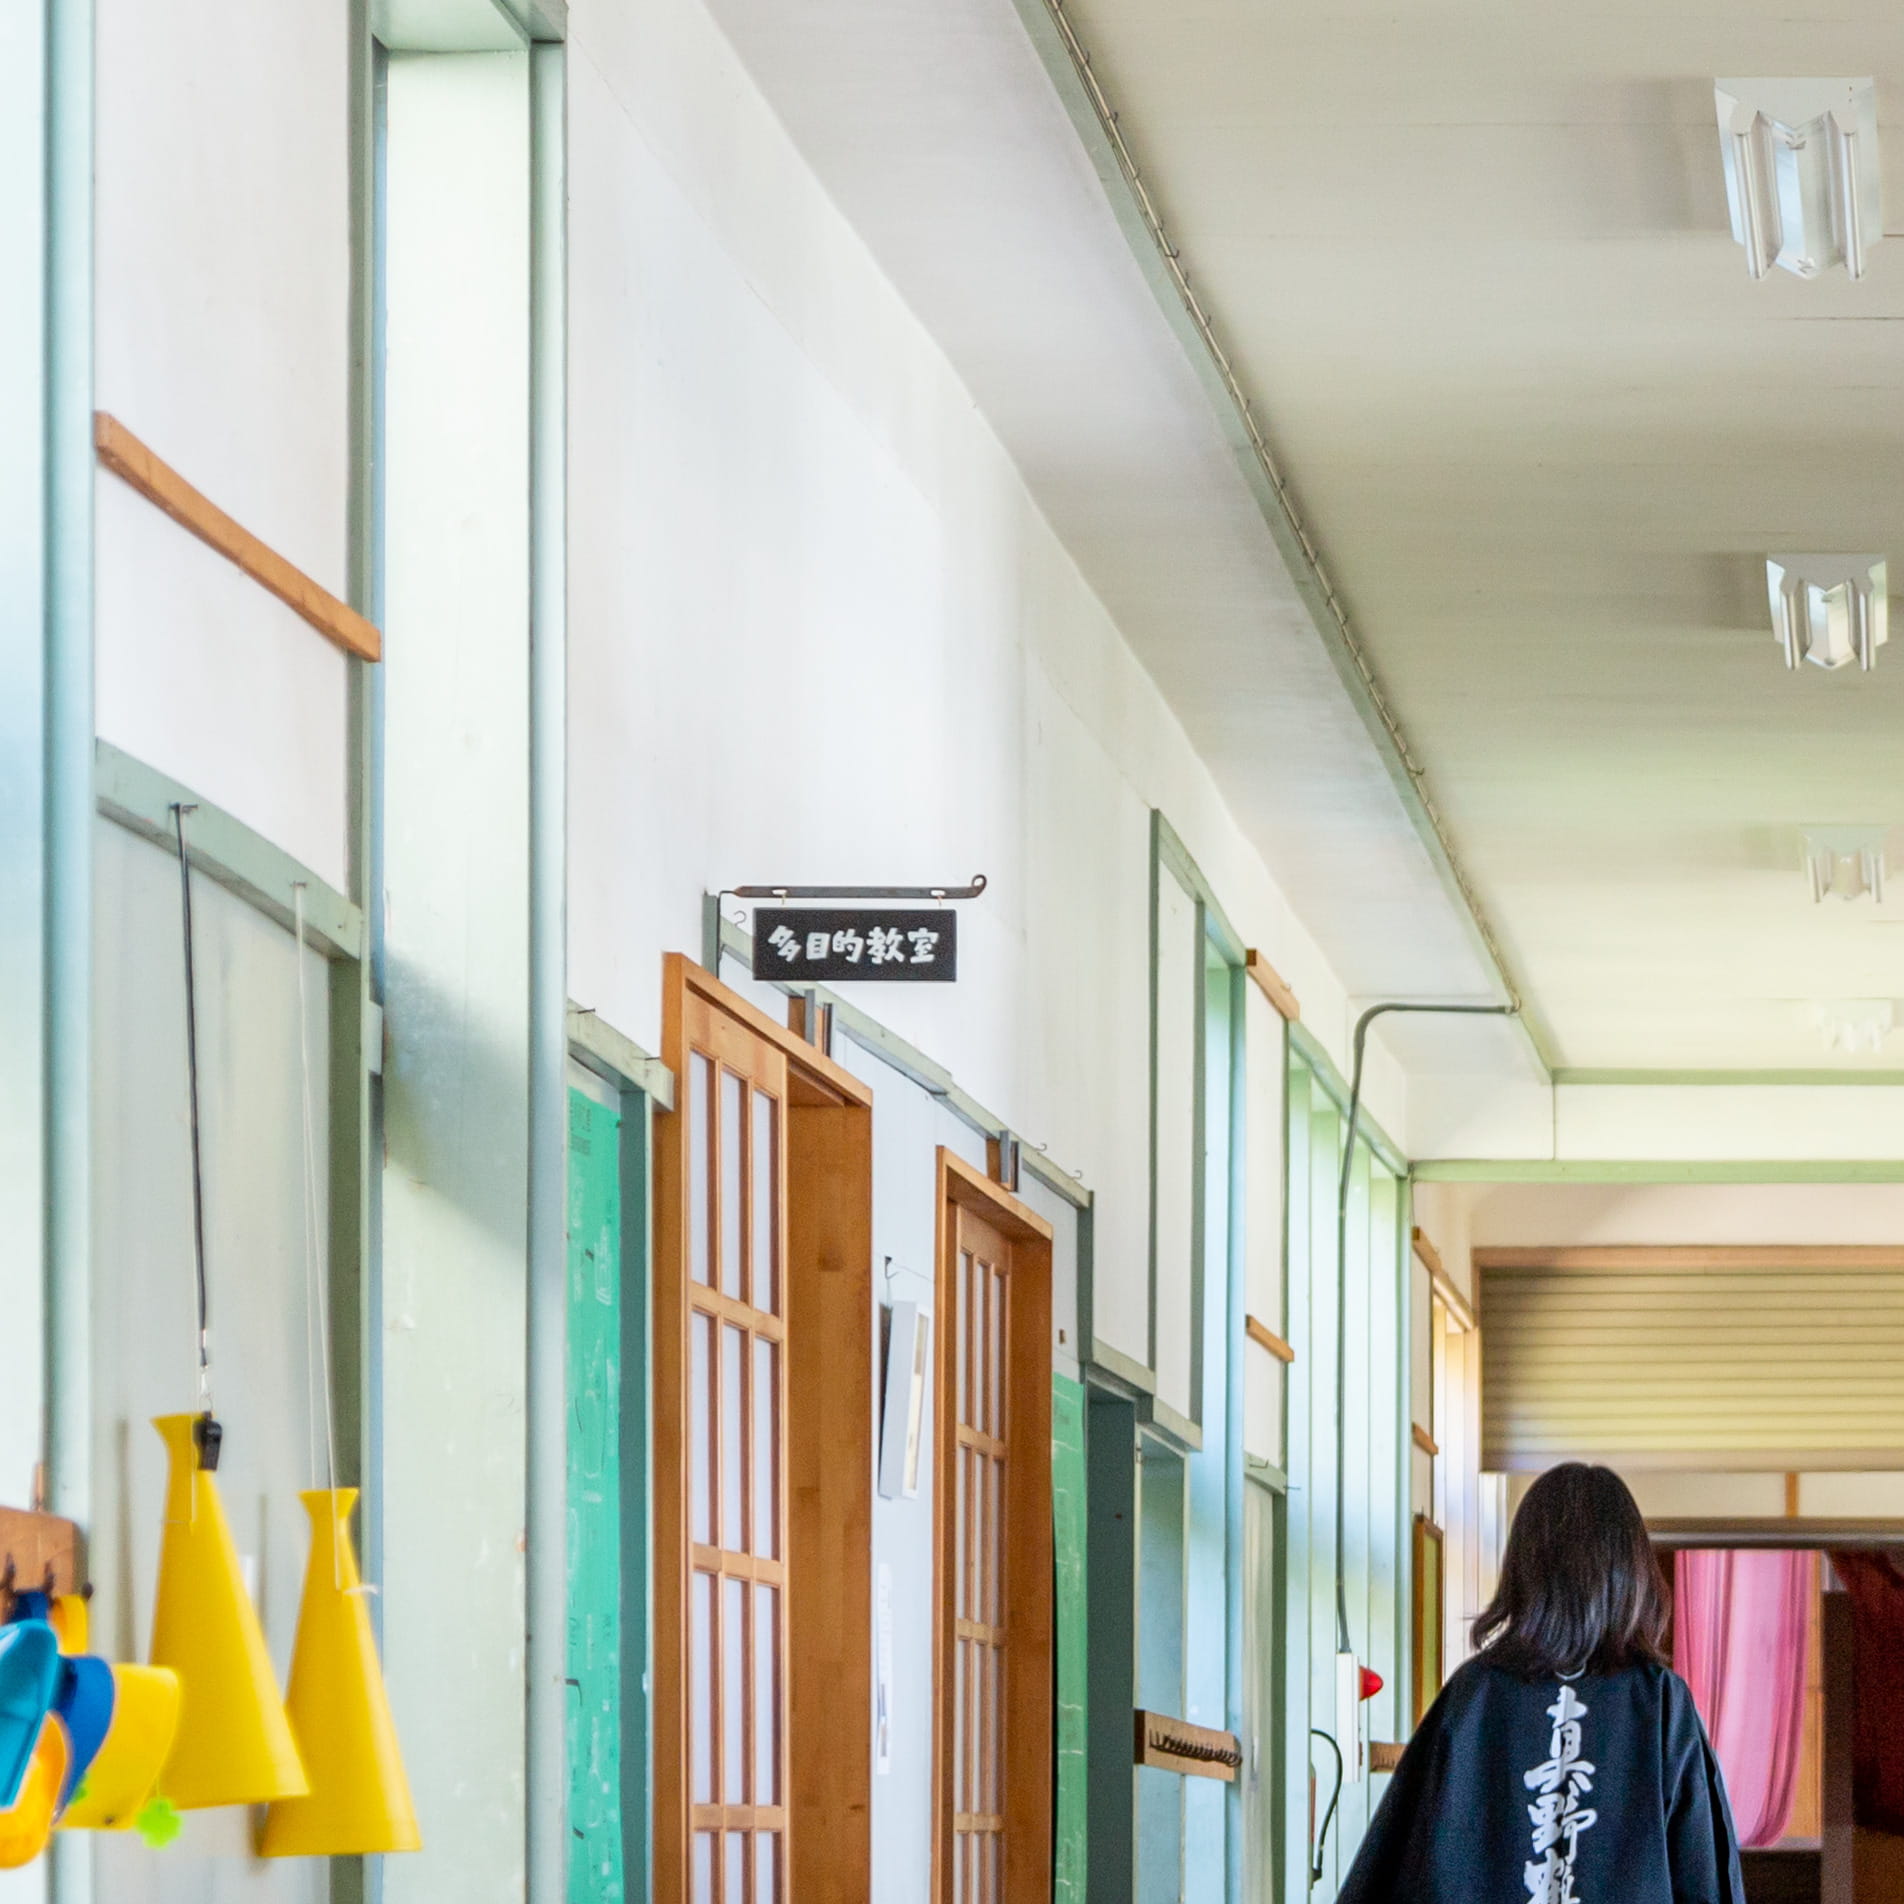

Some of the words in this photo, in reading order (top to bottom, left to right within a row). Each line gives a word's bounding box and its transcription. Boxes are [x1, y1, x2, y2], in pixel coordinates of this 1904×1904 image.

[767, 924, 939, 965] 多目的教室
